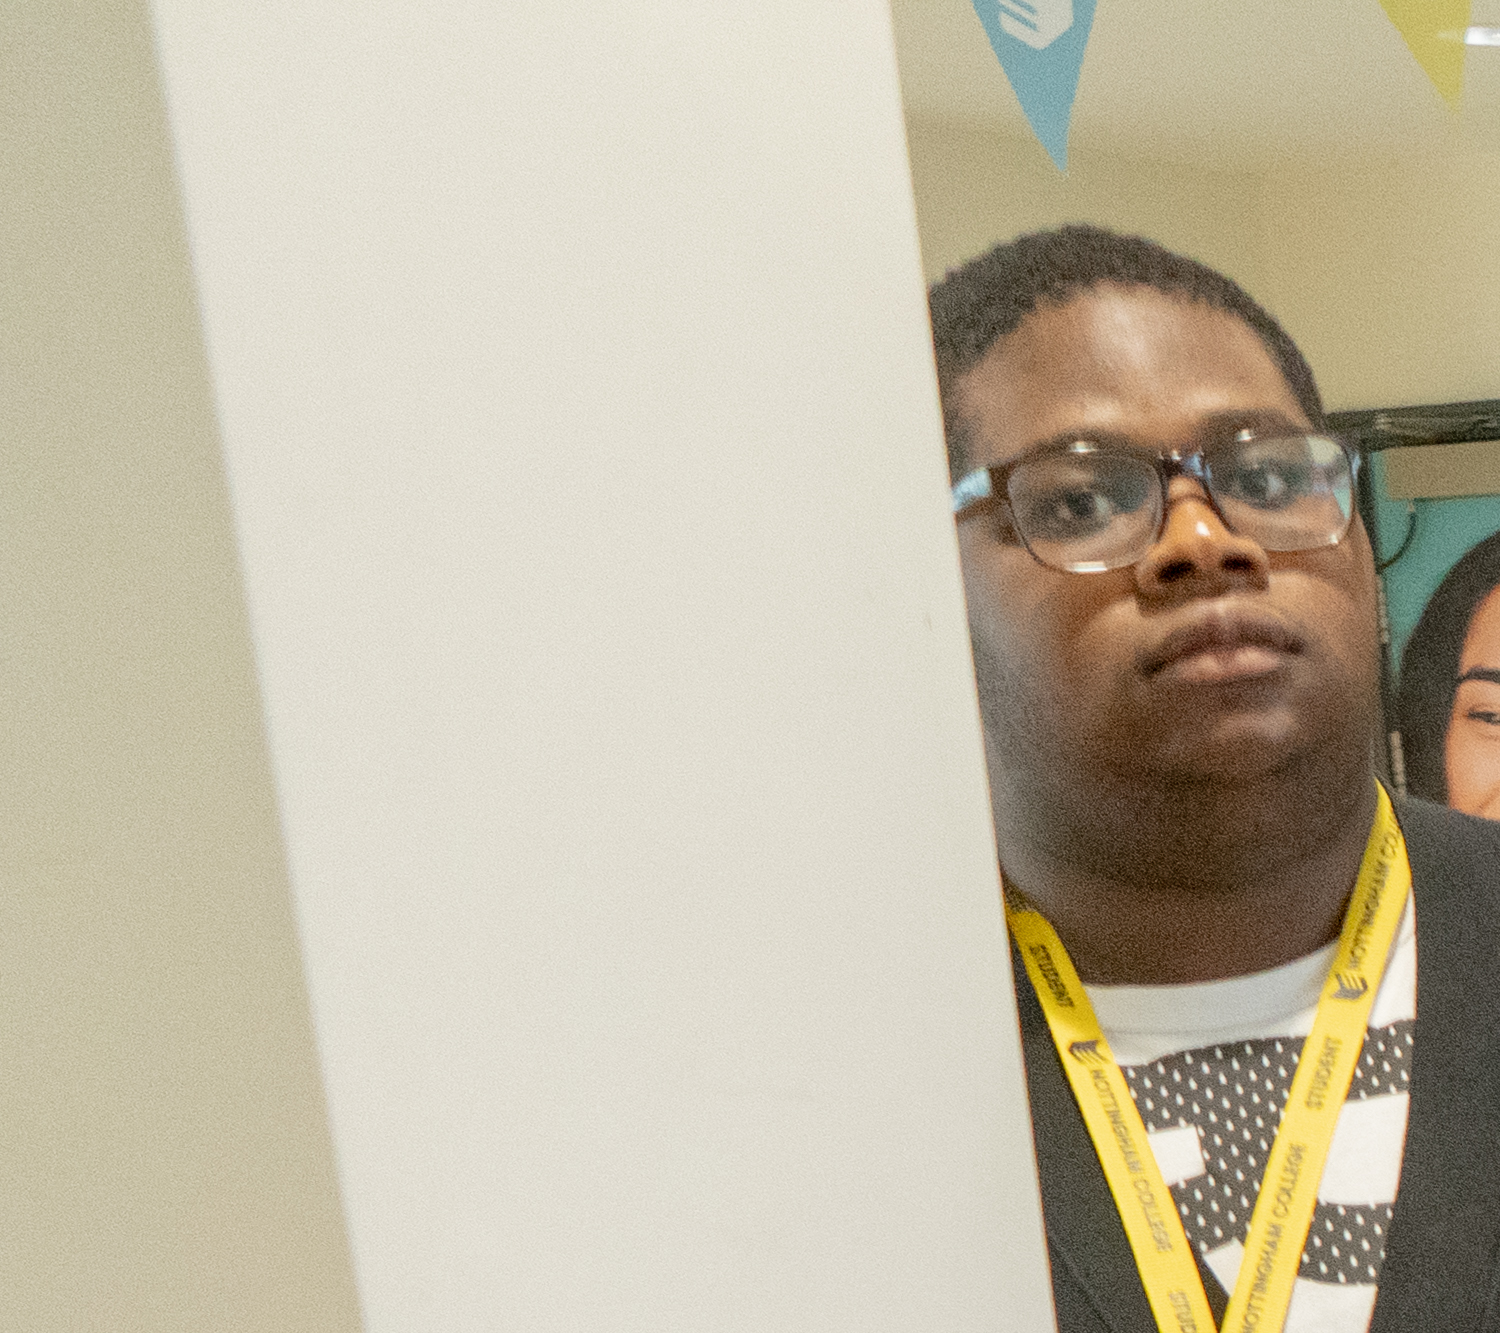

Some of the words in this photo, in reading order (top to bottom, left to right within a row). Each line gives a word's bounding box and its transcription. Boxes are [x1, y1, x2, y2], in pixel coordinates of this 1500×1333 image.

[1347, 860, 1389, 972] NOTTINGHAM
[1029, 943, 1075, 1010] STUDENT
[1306, 1037, 1342, 1111] STUDENT
[1090, 1068, 1143, 1174] NOTTINGHAM
[1133, 1179, 1174, 1254] COLLEGE
[1273, 1143, 1307, 1221] COLLEGE
